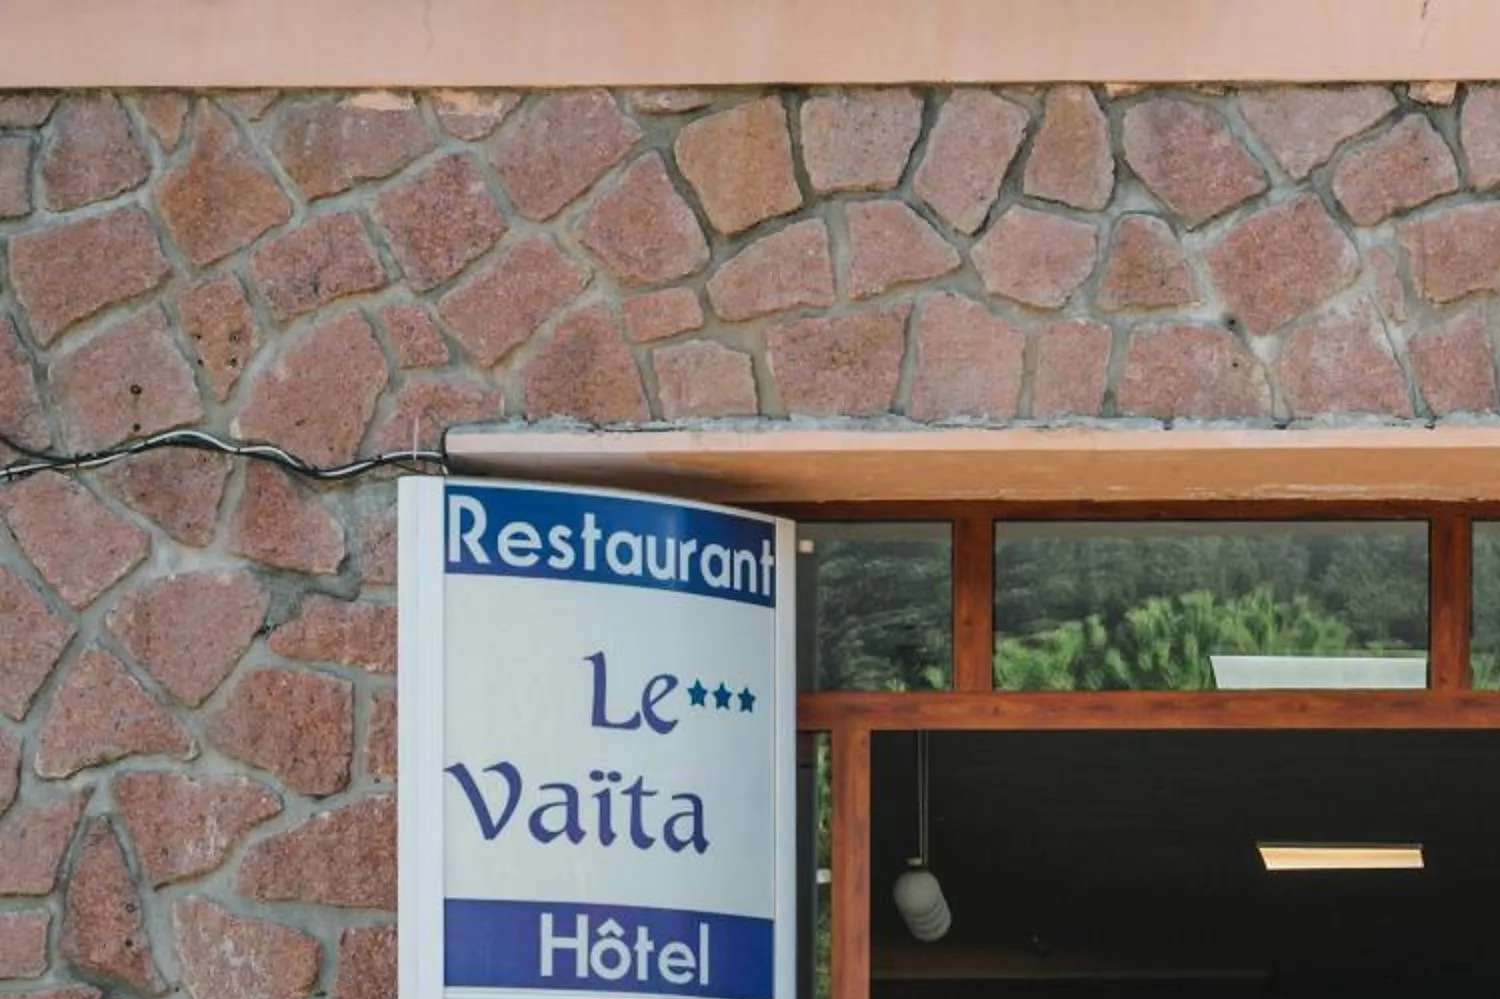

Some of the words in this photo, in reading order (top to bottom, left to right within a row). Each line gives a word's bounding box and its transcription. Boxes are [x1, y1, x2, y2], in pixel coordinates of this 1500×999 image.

[447, 494, 776, 597] Restaurant
[583, 650, 680, 735] Le
[443, 760, 710, 855] Vaïta
[539, 912, 710, 985] Hôtel
